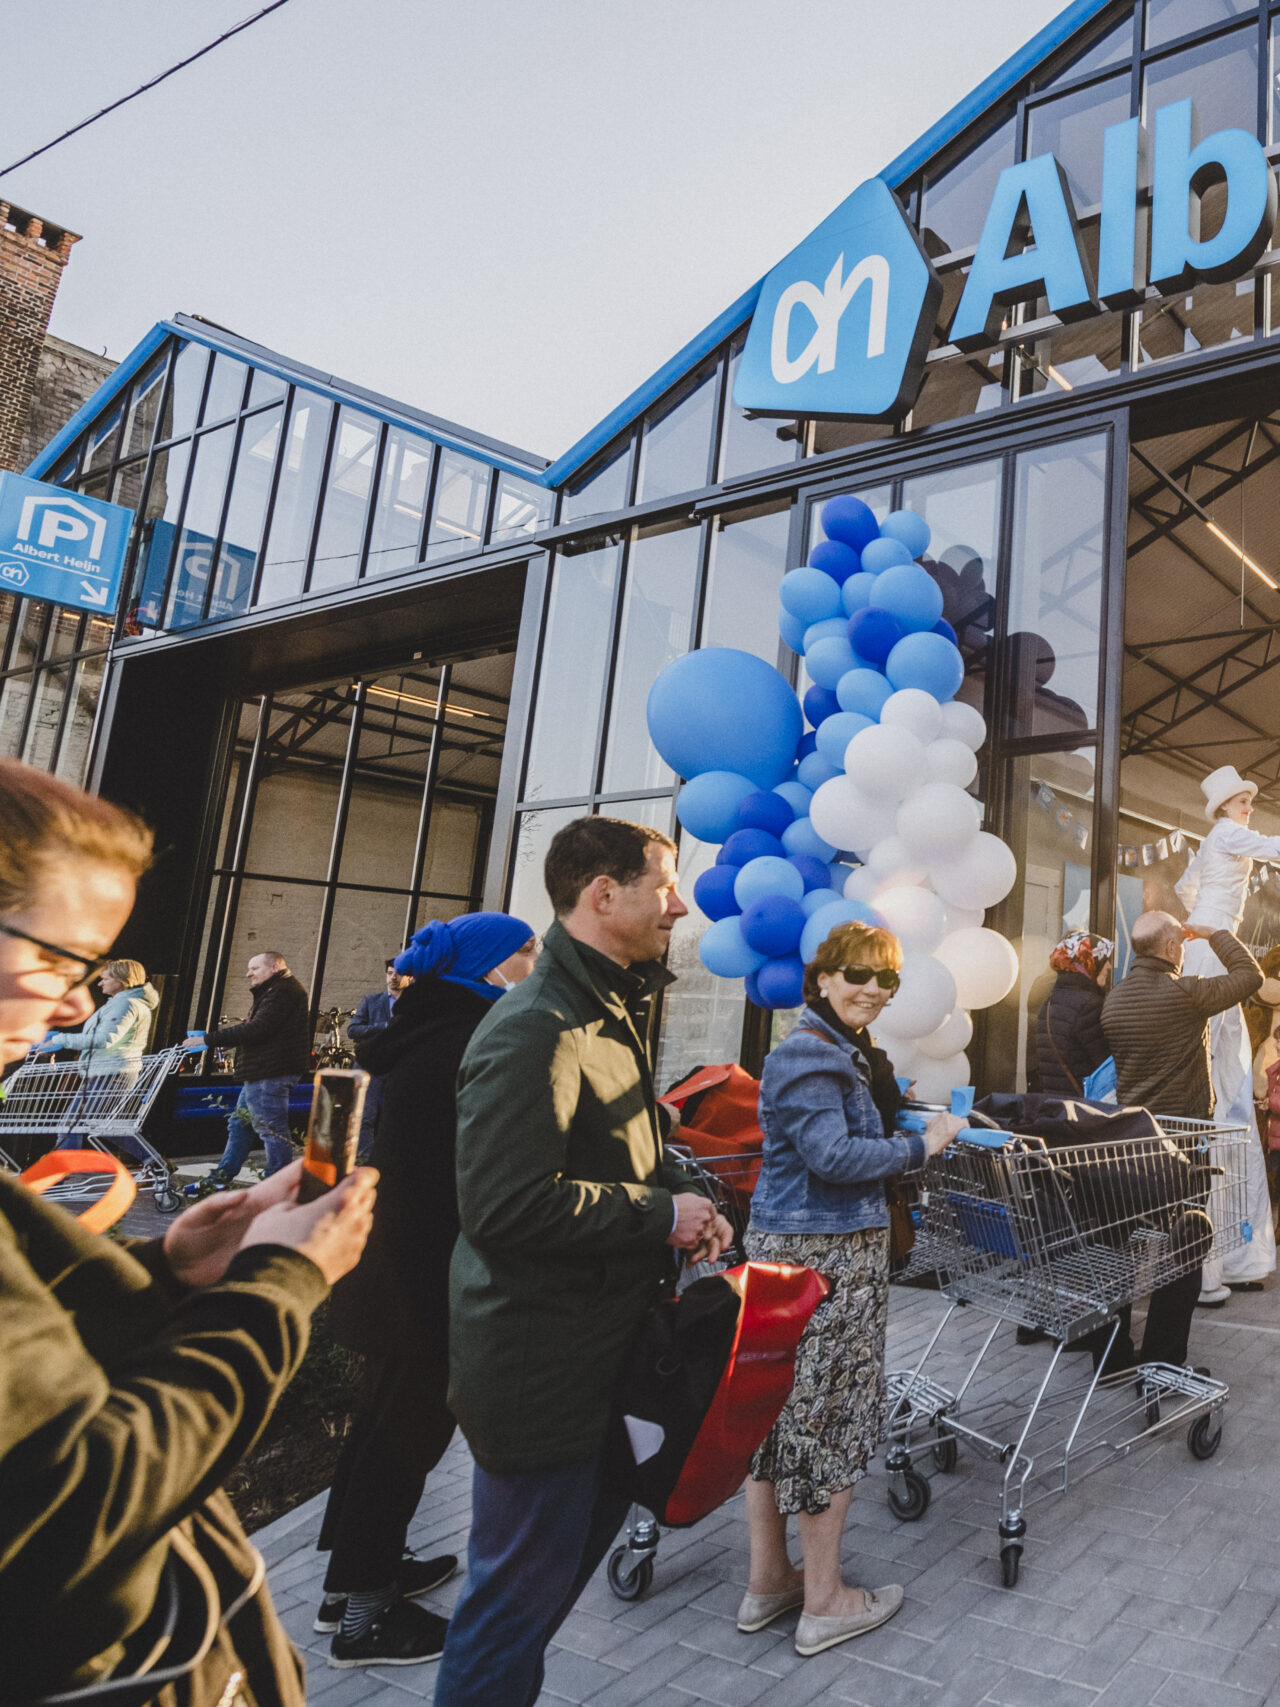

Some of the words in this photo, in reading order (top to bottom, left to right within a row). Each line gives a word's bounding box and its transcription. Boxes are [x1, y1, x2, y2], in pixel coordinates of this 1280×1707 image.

[38, 508, 89, 548] P
[12, 542, 60, 563] Albert
[63, 554, 101, 573] Heijn
